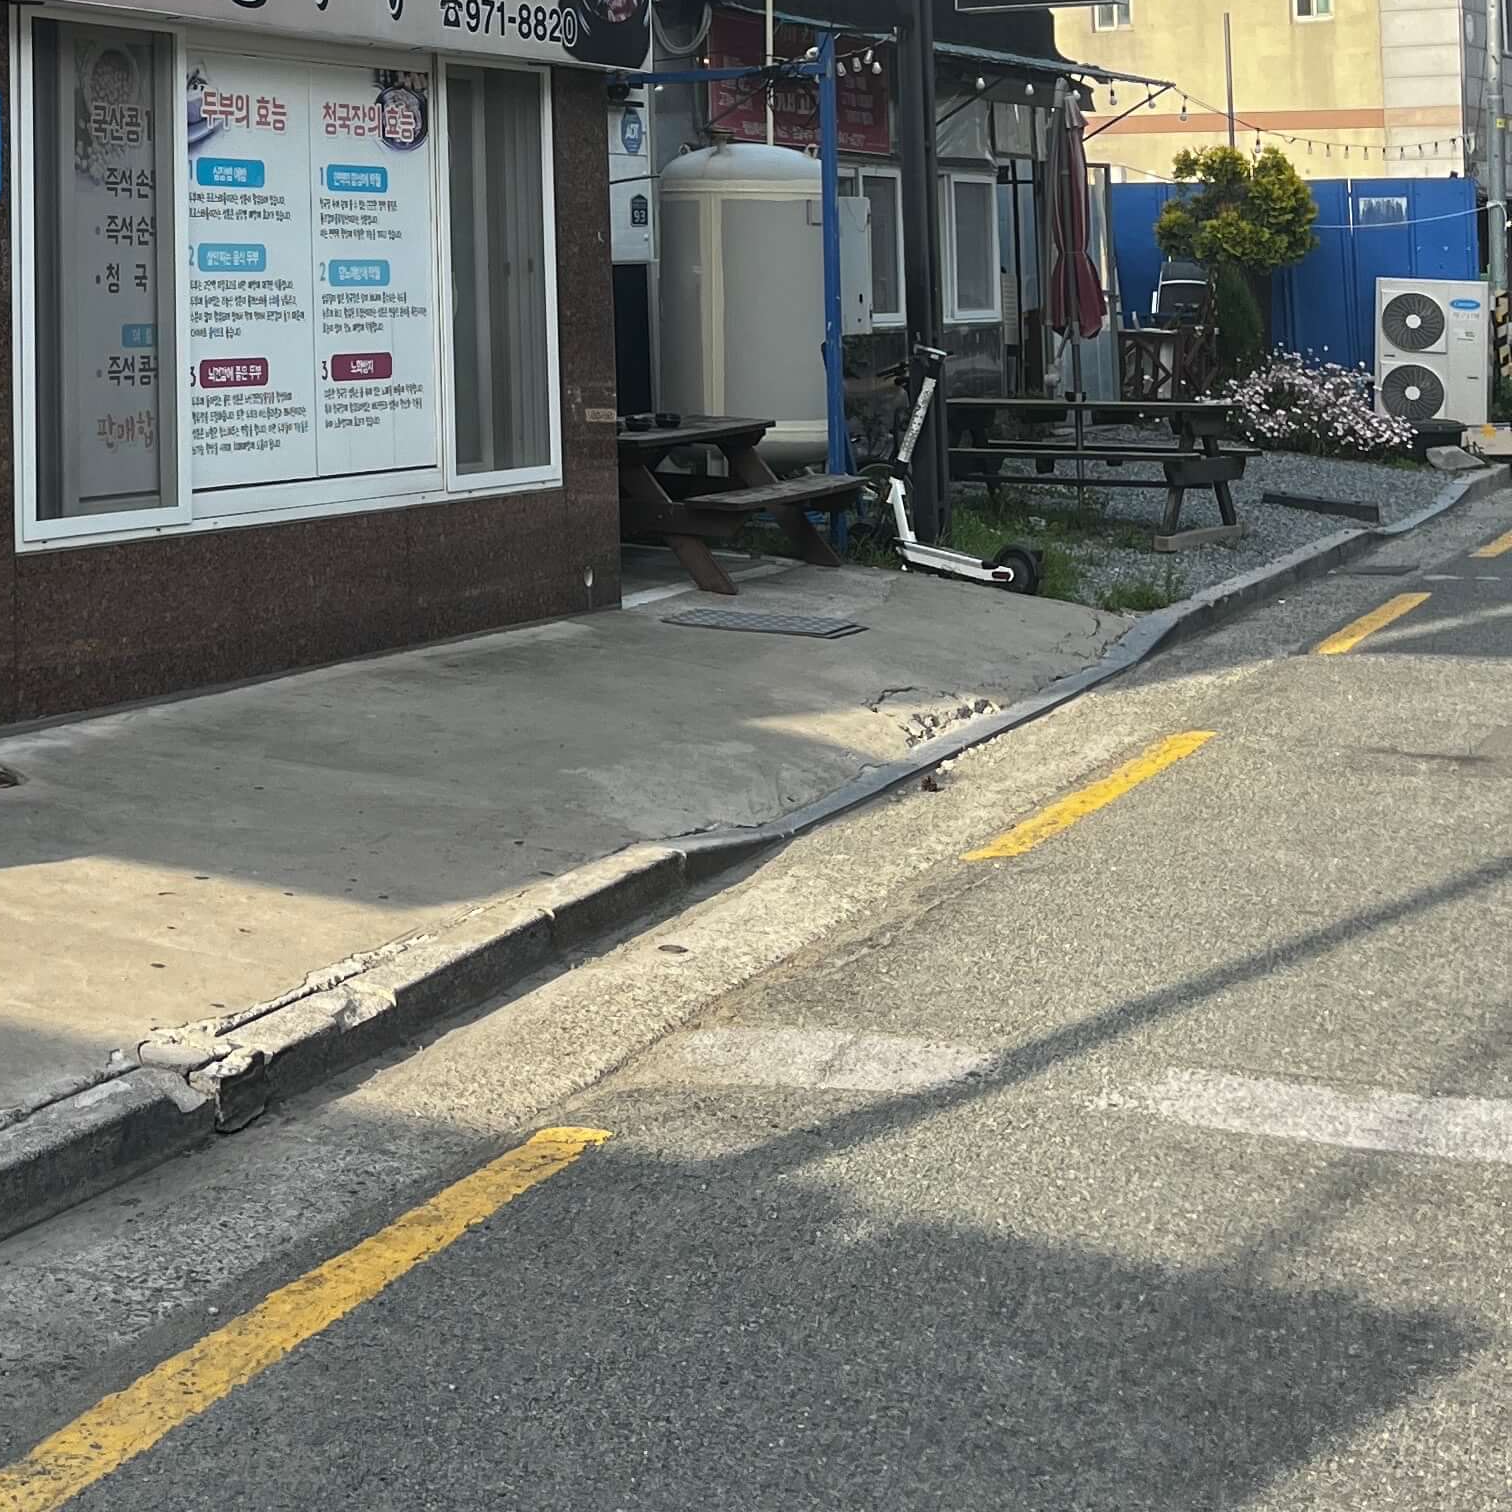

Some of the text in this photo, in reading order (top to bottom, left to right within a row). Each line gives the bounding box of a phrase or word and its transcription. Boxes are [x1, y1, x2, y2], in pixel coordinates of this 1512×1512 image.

[201, 90, 288, 131] 두부의 효능
[322, 102, 416, 142] 청국장의 효능
[105, 168, 133, 198] 즉석
[106, 216, 133, 246] 즉석
[633, 209, 646, 223] 93
[108, 355, 135, 386] 즉석
